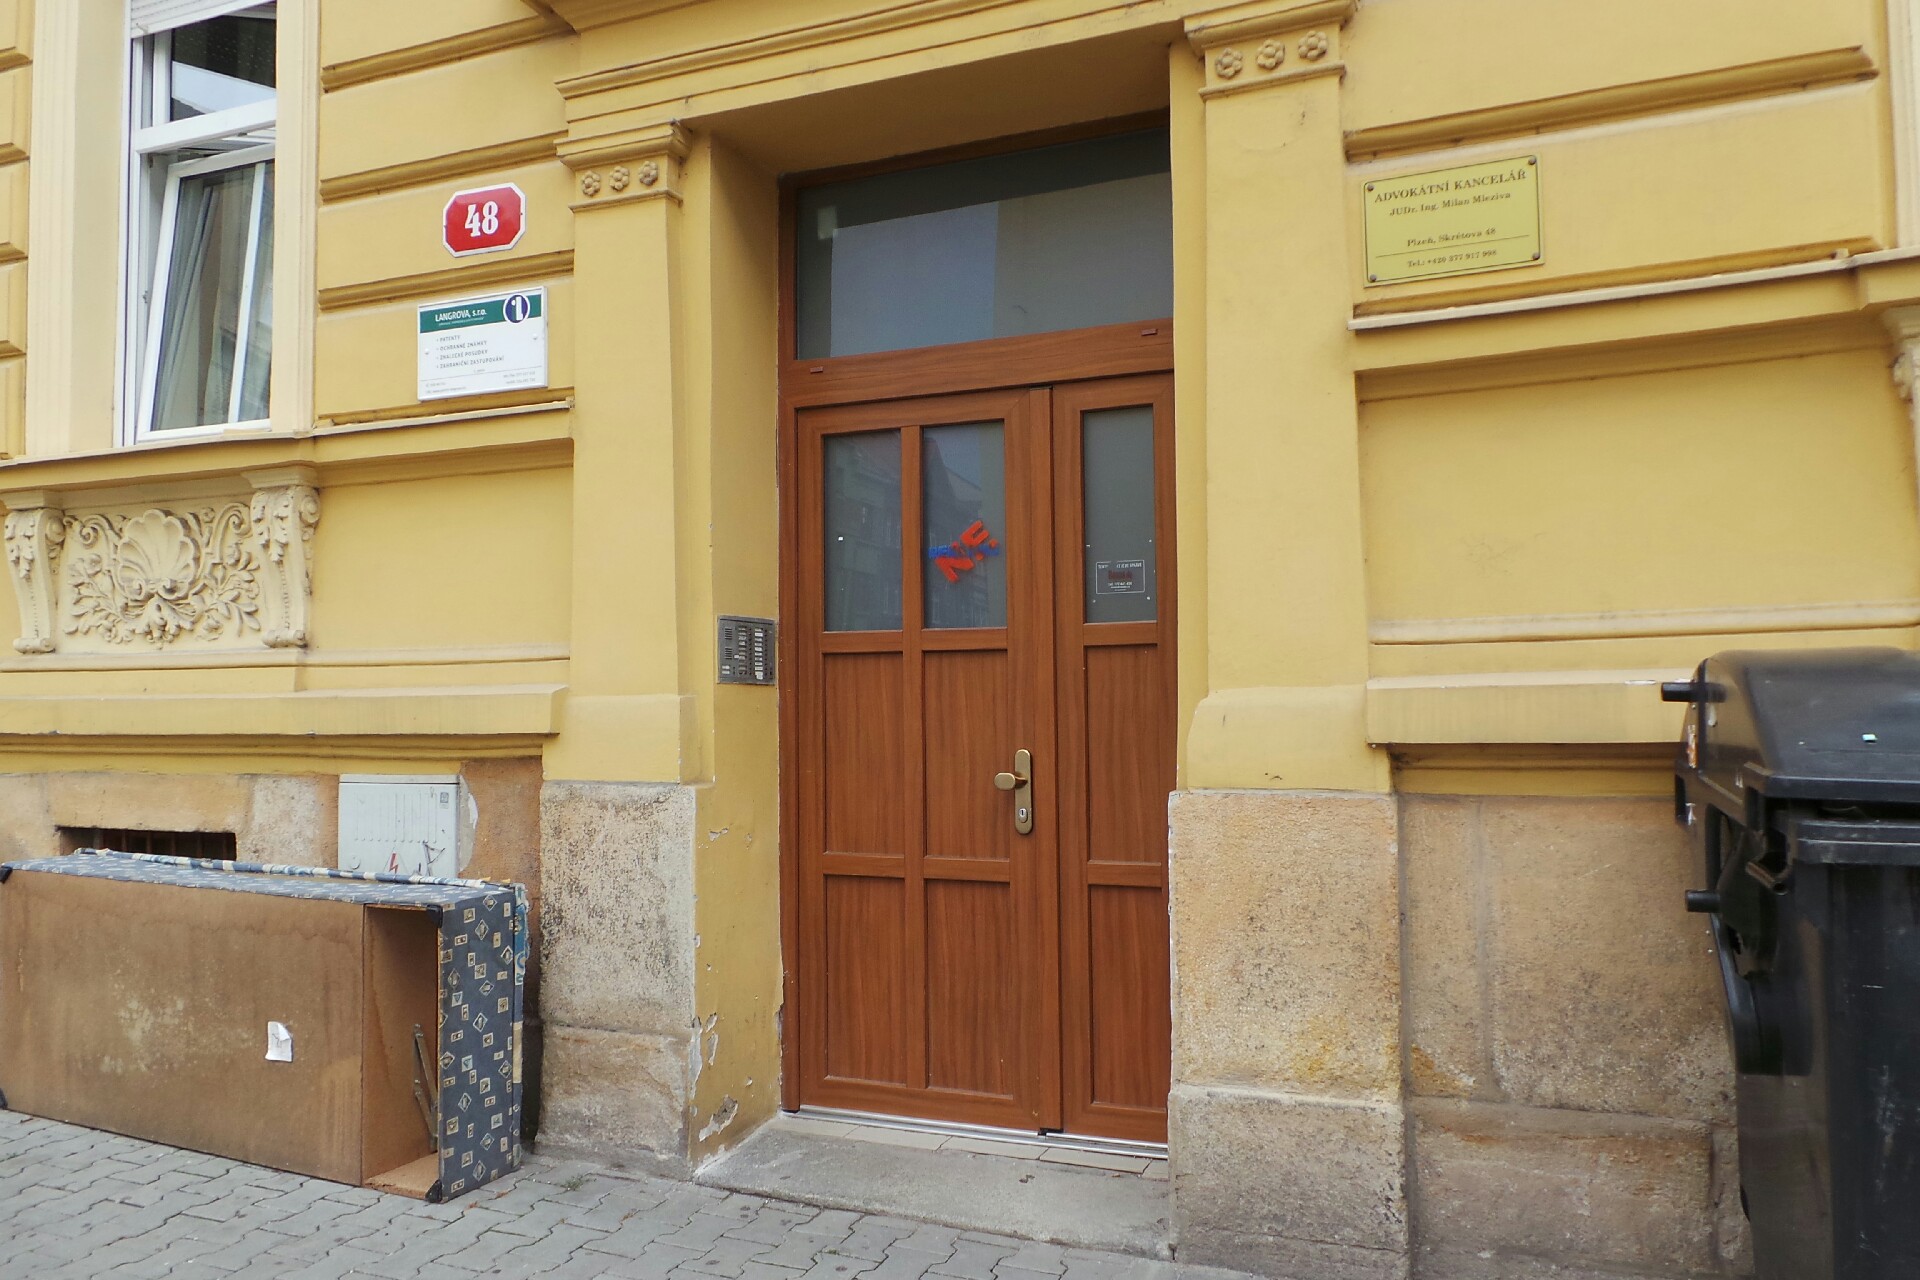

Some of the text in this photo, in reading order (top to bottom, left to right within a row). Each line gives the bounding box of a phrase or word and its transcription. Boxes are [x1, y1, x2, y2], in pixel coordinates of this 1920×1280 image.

[1374, 169, 1527, 204] ADVOKÁTNÍ KANCELÁŘ
[465, 201, 498, 237] 48
[1389, 204, 1418, 216] JUDr.
[1442, 198, 1470, 208] Milan
